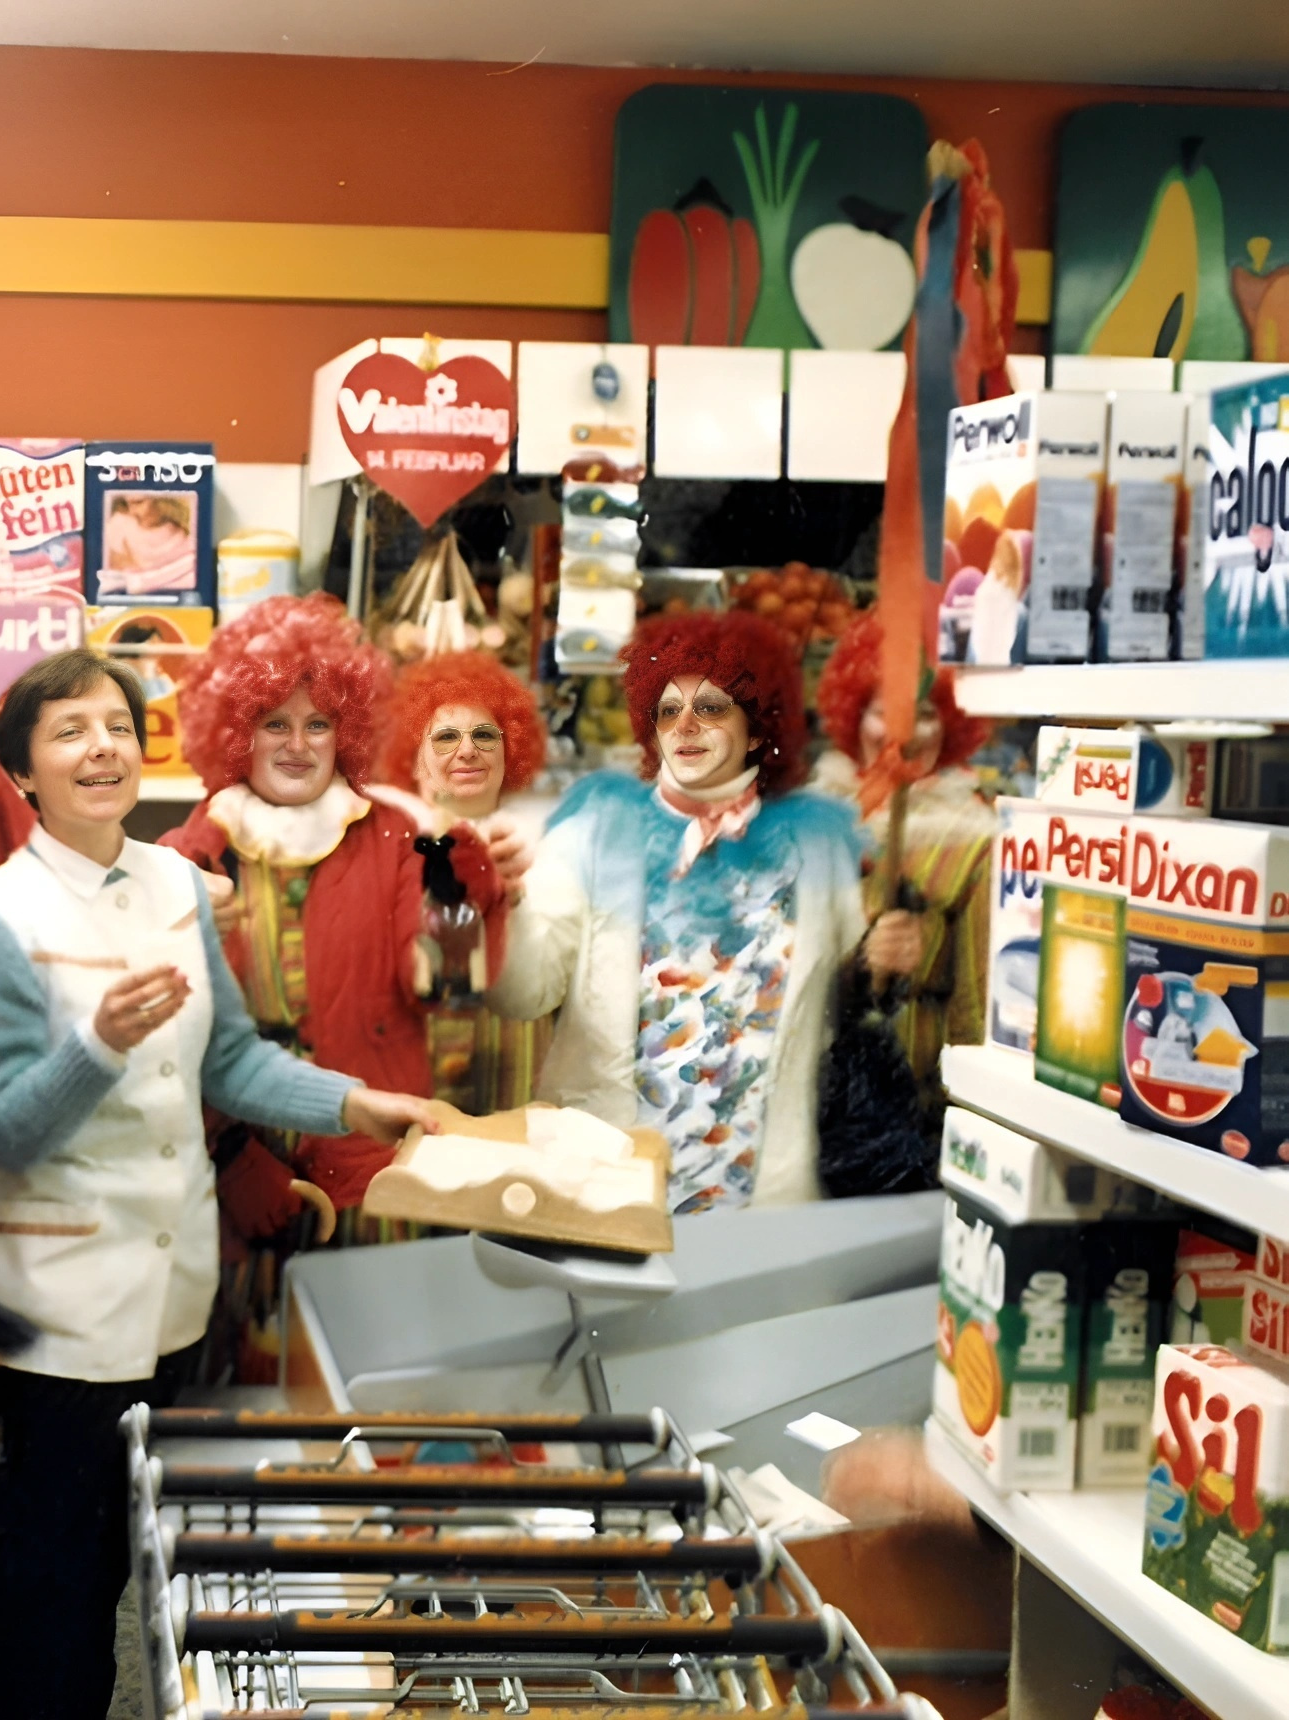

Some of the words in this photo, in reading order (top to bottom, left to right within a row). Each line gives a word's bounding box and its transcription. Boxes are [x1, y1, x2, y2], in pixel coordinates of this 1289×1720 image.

[338, 387, 509, 445] Valentinstag
[392, 450, 486, 471] FEBRUAR
[0, 496, 78, 541] fein
[1130, 830, 1258, 915] Dixan
[1157, 1369, 1263, 1537] Sil
